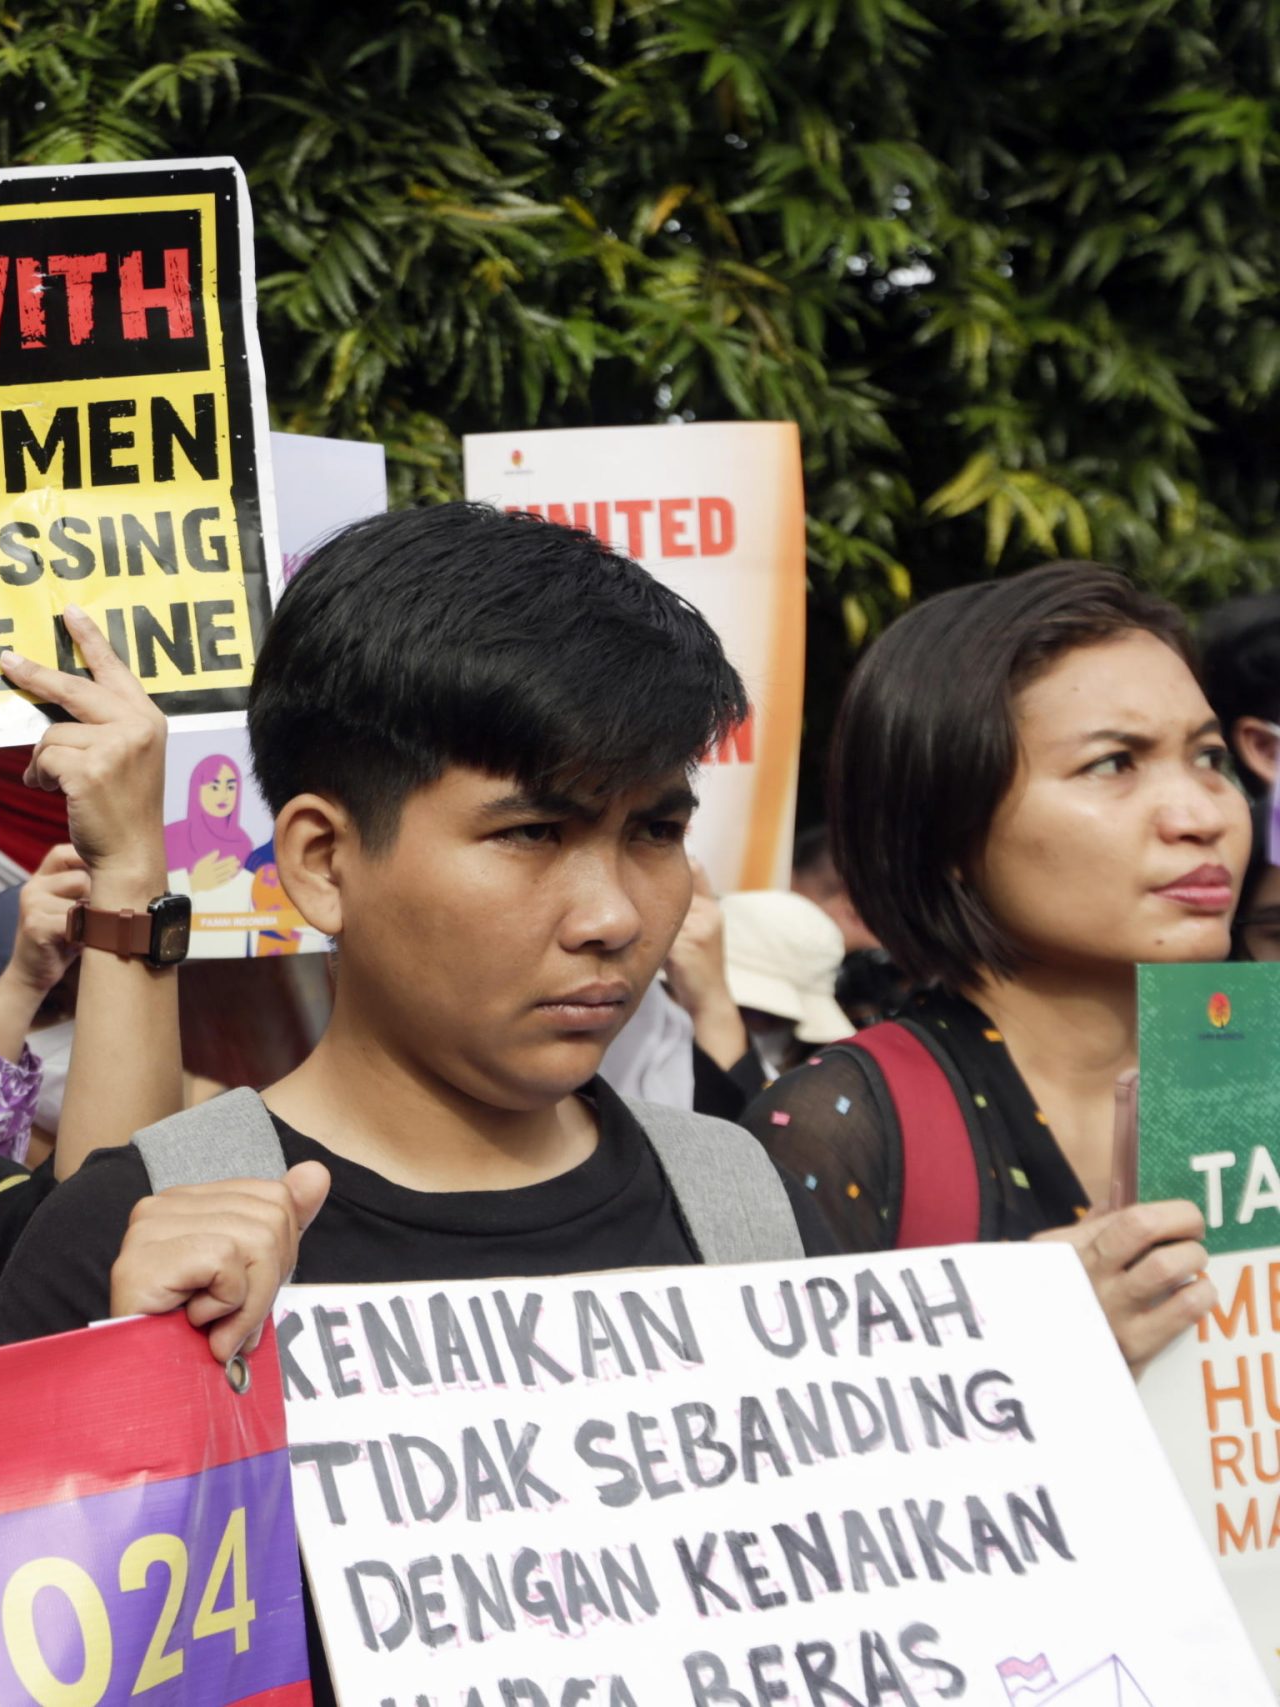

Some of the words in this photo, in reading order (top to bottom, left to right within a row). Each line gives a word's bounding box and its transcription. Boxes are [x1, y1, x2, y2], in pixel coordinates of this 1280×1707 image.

[504, 497, 736, 559] ITED
[53, 599, 243, 681] LINE
[276, 1286, 705, 1401] KENAIKAN
[740, 1258, 984, 1359] UPAH
[289, 1418, 562, 1526] TIDAK
[574, 1369, 1037, 1509] SEBANDING
[344, 1546, 660, 1653] DENGAN
[673, 1485, 1076, 1617] KENAIKAN
[683, 1622, 967, 1707] BERAS
